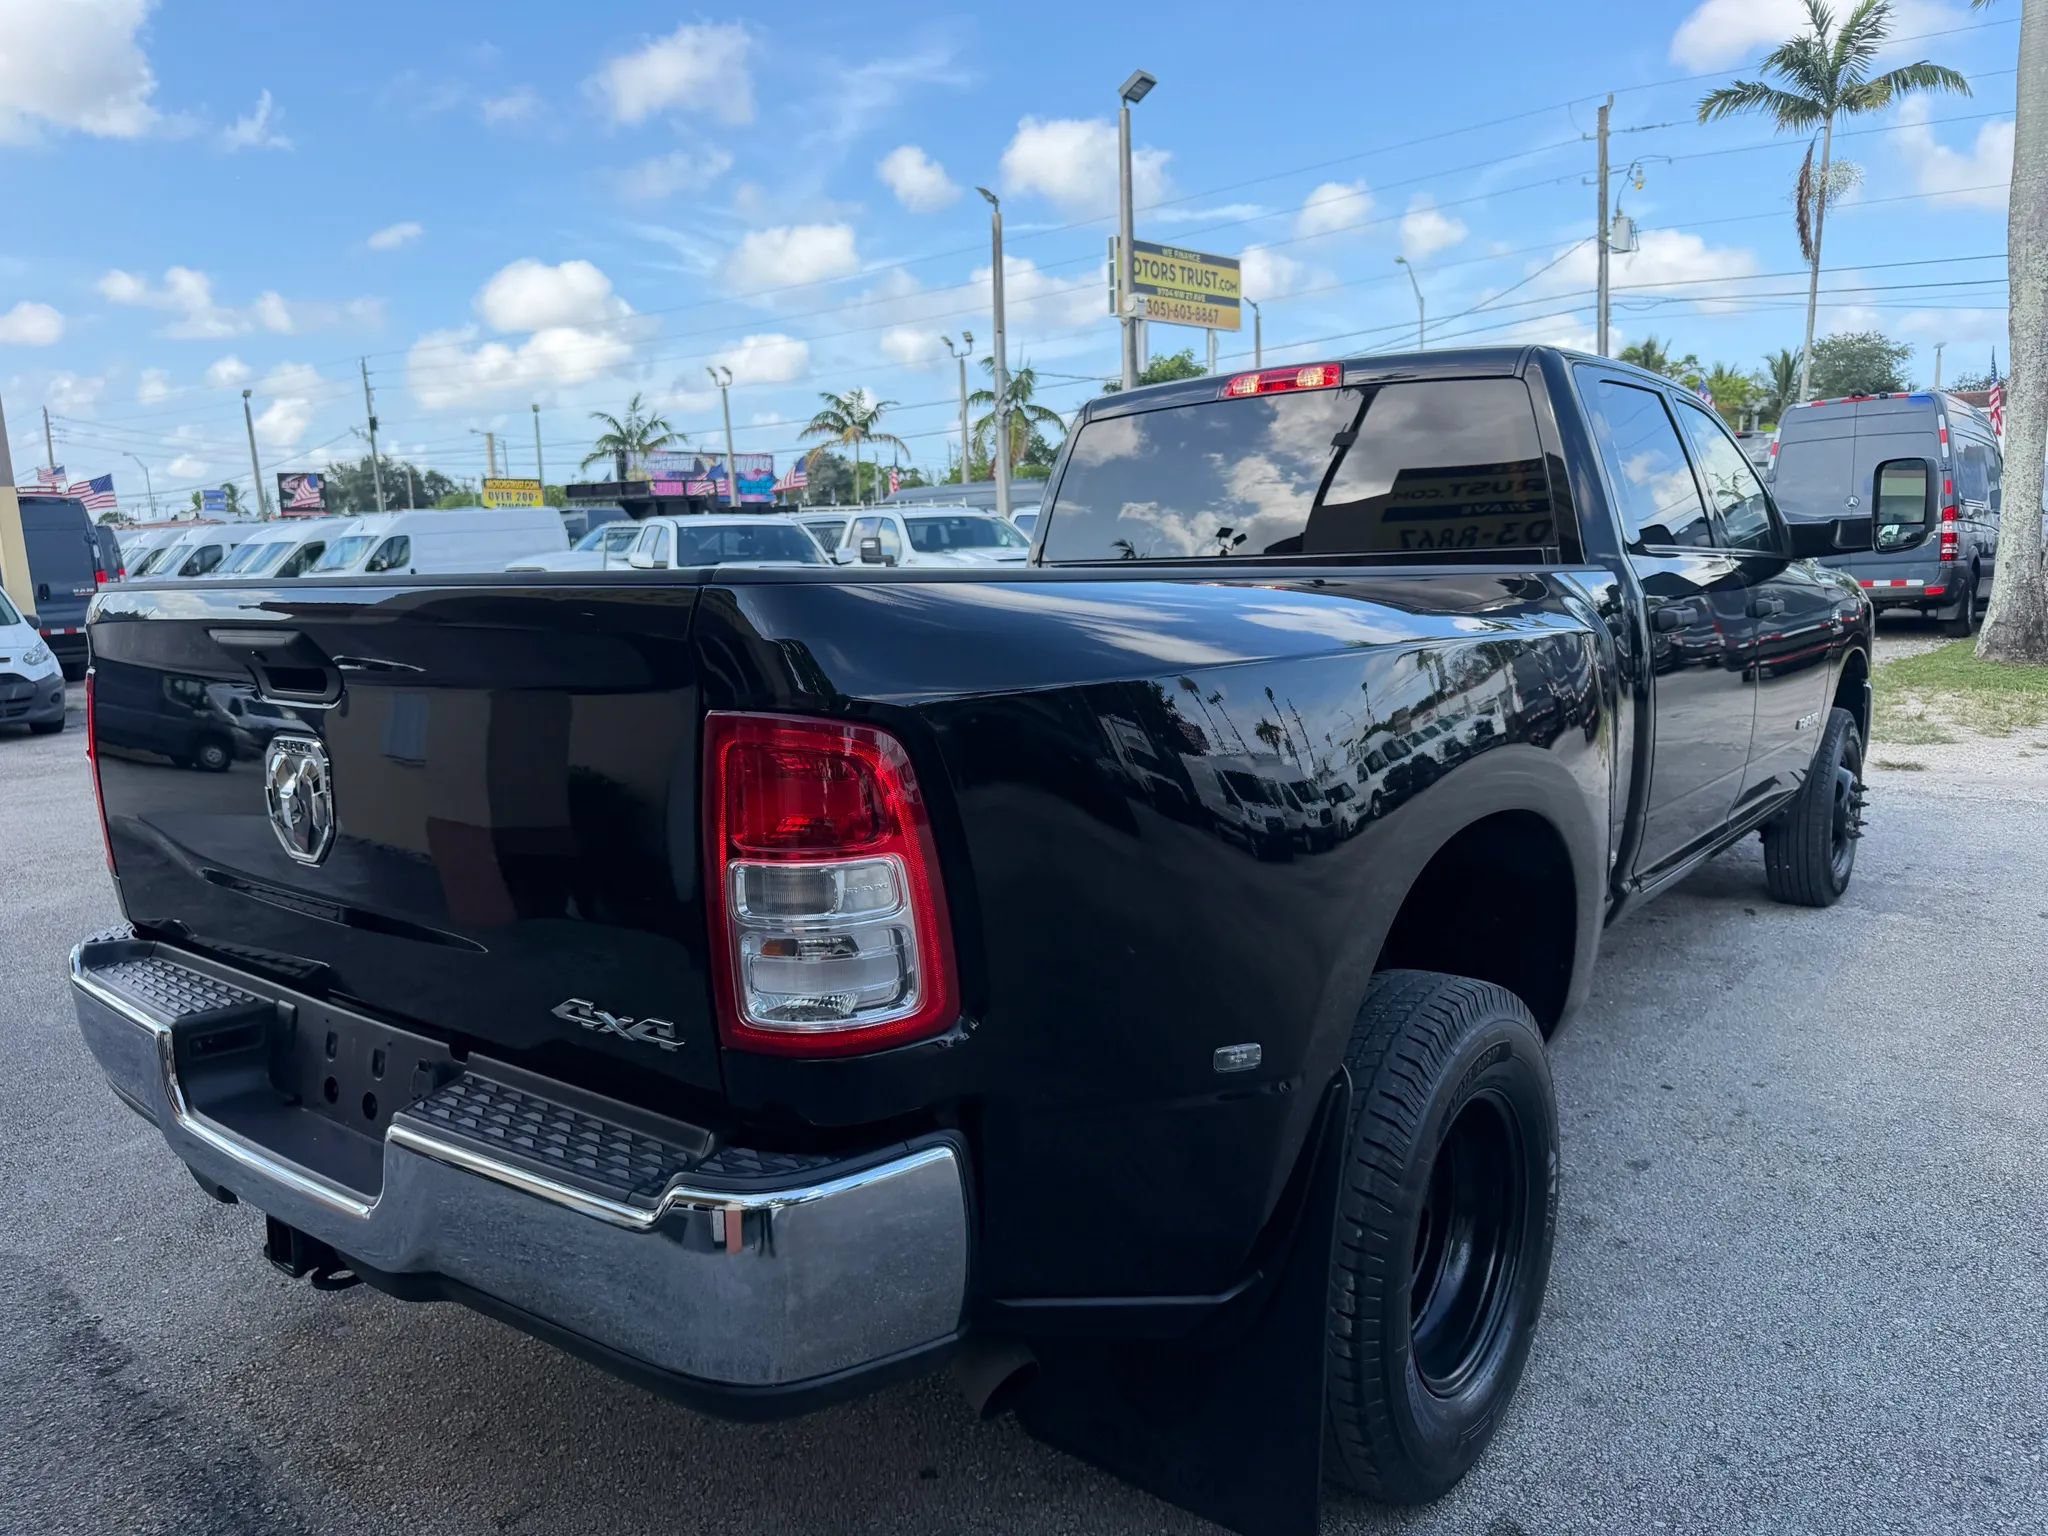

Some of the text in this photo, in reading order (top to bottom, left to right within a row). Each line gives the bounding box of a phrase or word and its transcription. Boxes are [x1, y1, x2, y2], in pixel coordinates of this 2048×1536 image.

[1134, 257, 1176, 283] OTORS
[1146, 298, 1219, 323] 305)-603-8867
[277, 740, 313, 754] RAM
[844, 882, 889, 894] RAM
